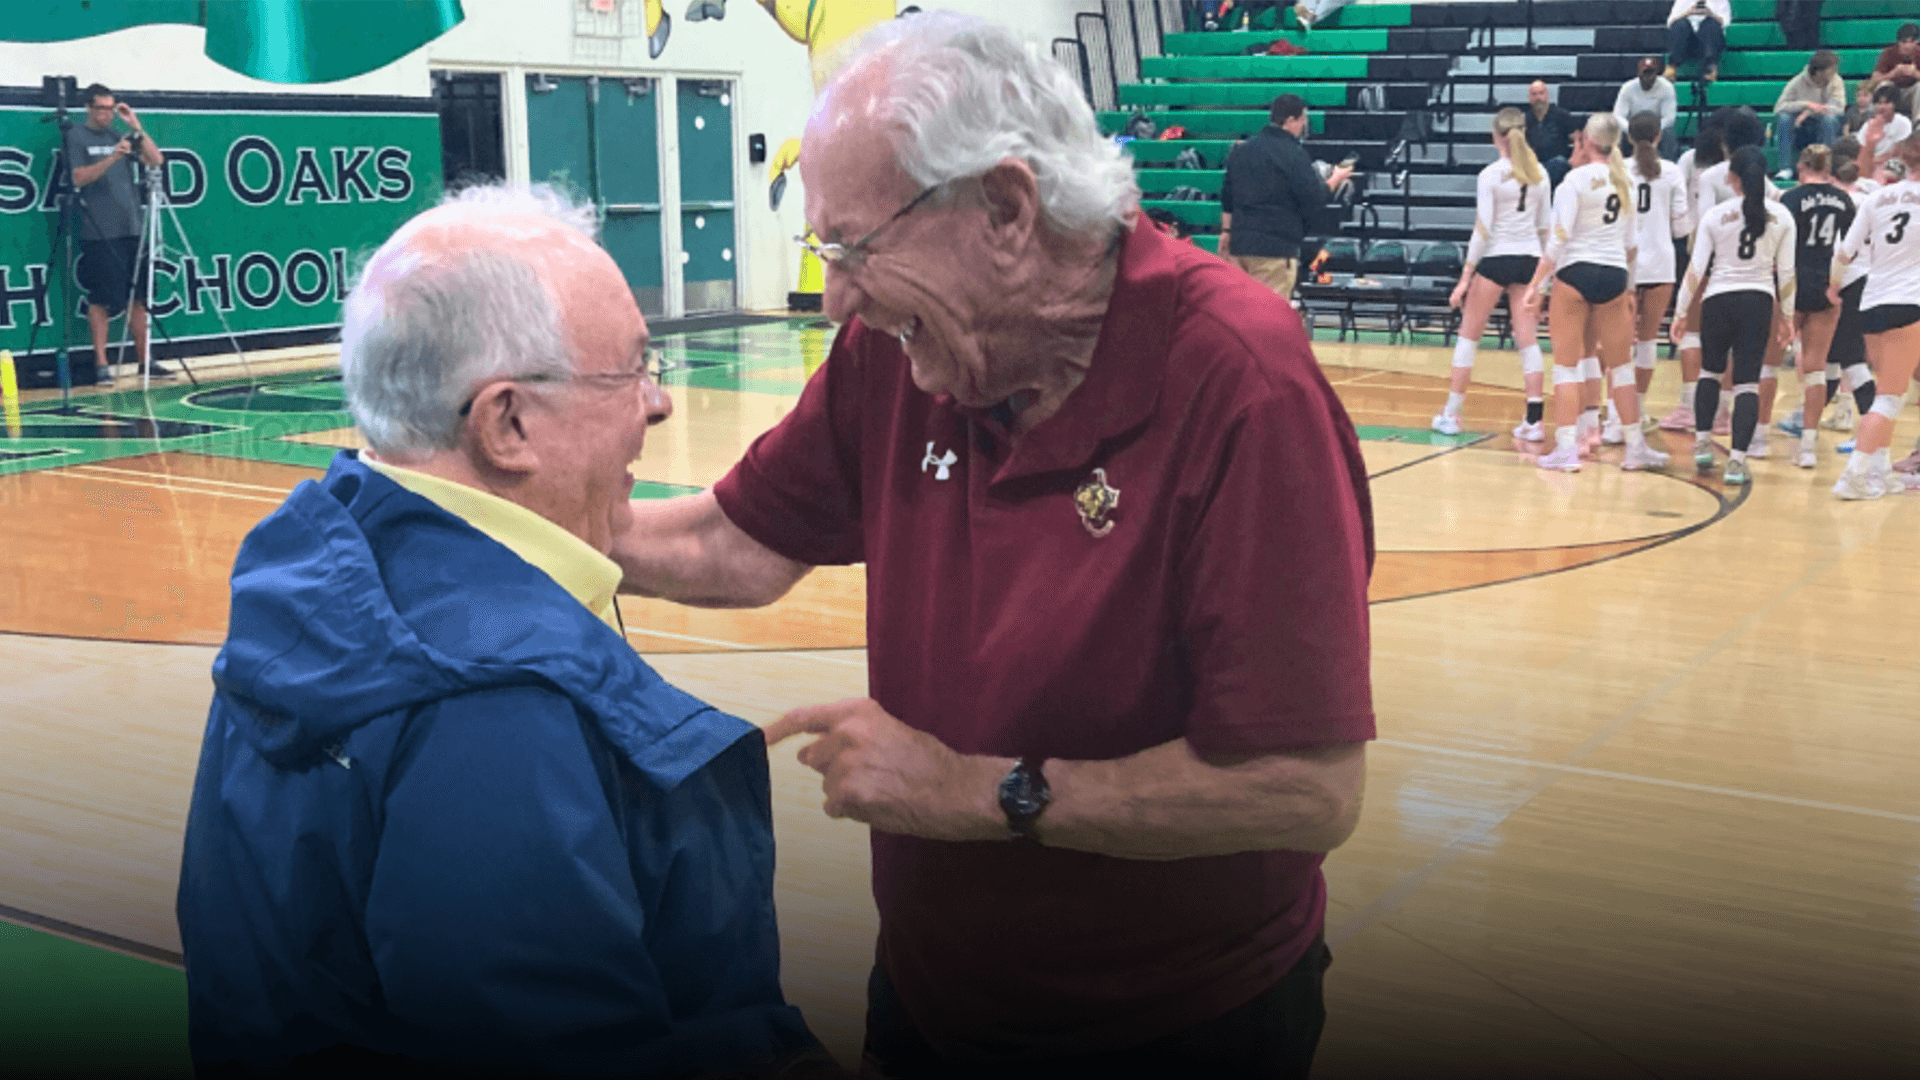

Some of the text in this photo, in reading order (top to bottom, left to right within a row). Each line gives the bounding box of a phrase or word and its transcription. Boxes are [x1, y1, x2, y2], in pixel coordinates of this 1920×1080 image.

[225, 135, 414, 206] OAKS
[1516, 182, 1528, 212] 1
[1602, 193, 1621, 225] 9
[1806, 213, 1836, 246] 14
[1885, 212, 1910, 244] 3
[1738, 229, 1756, 260] 8
[73, 247, 352, 319] CHOOL
